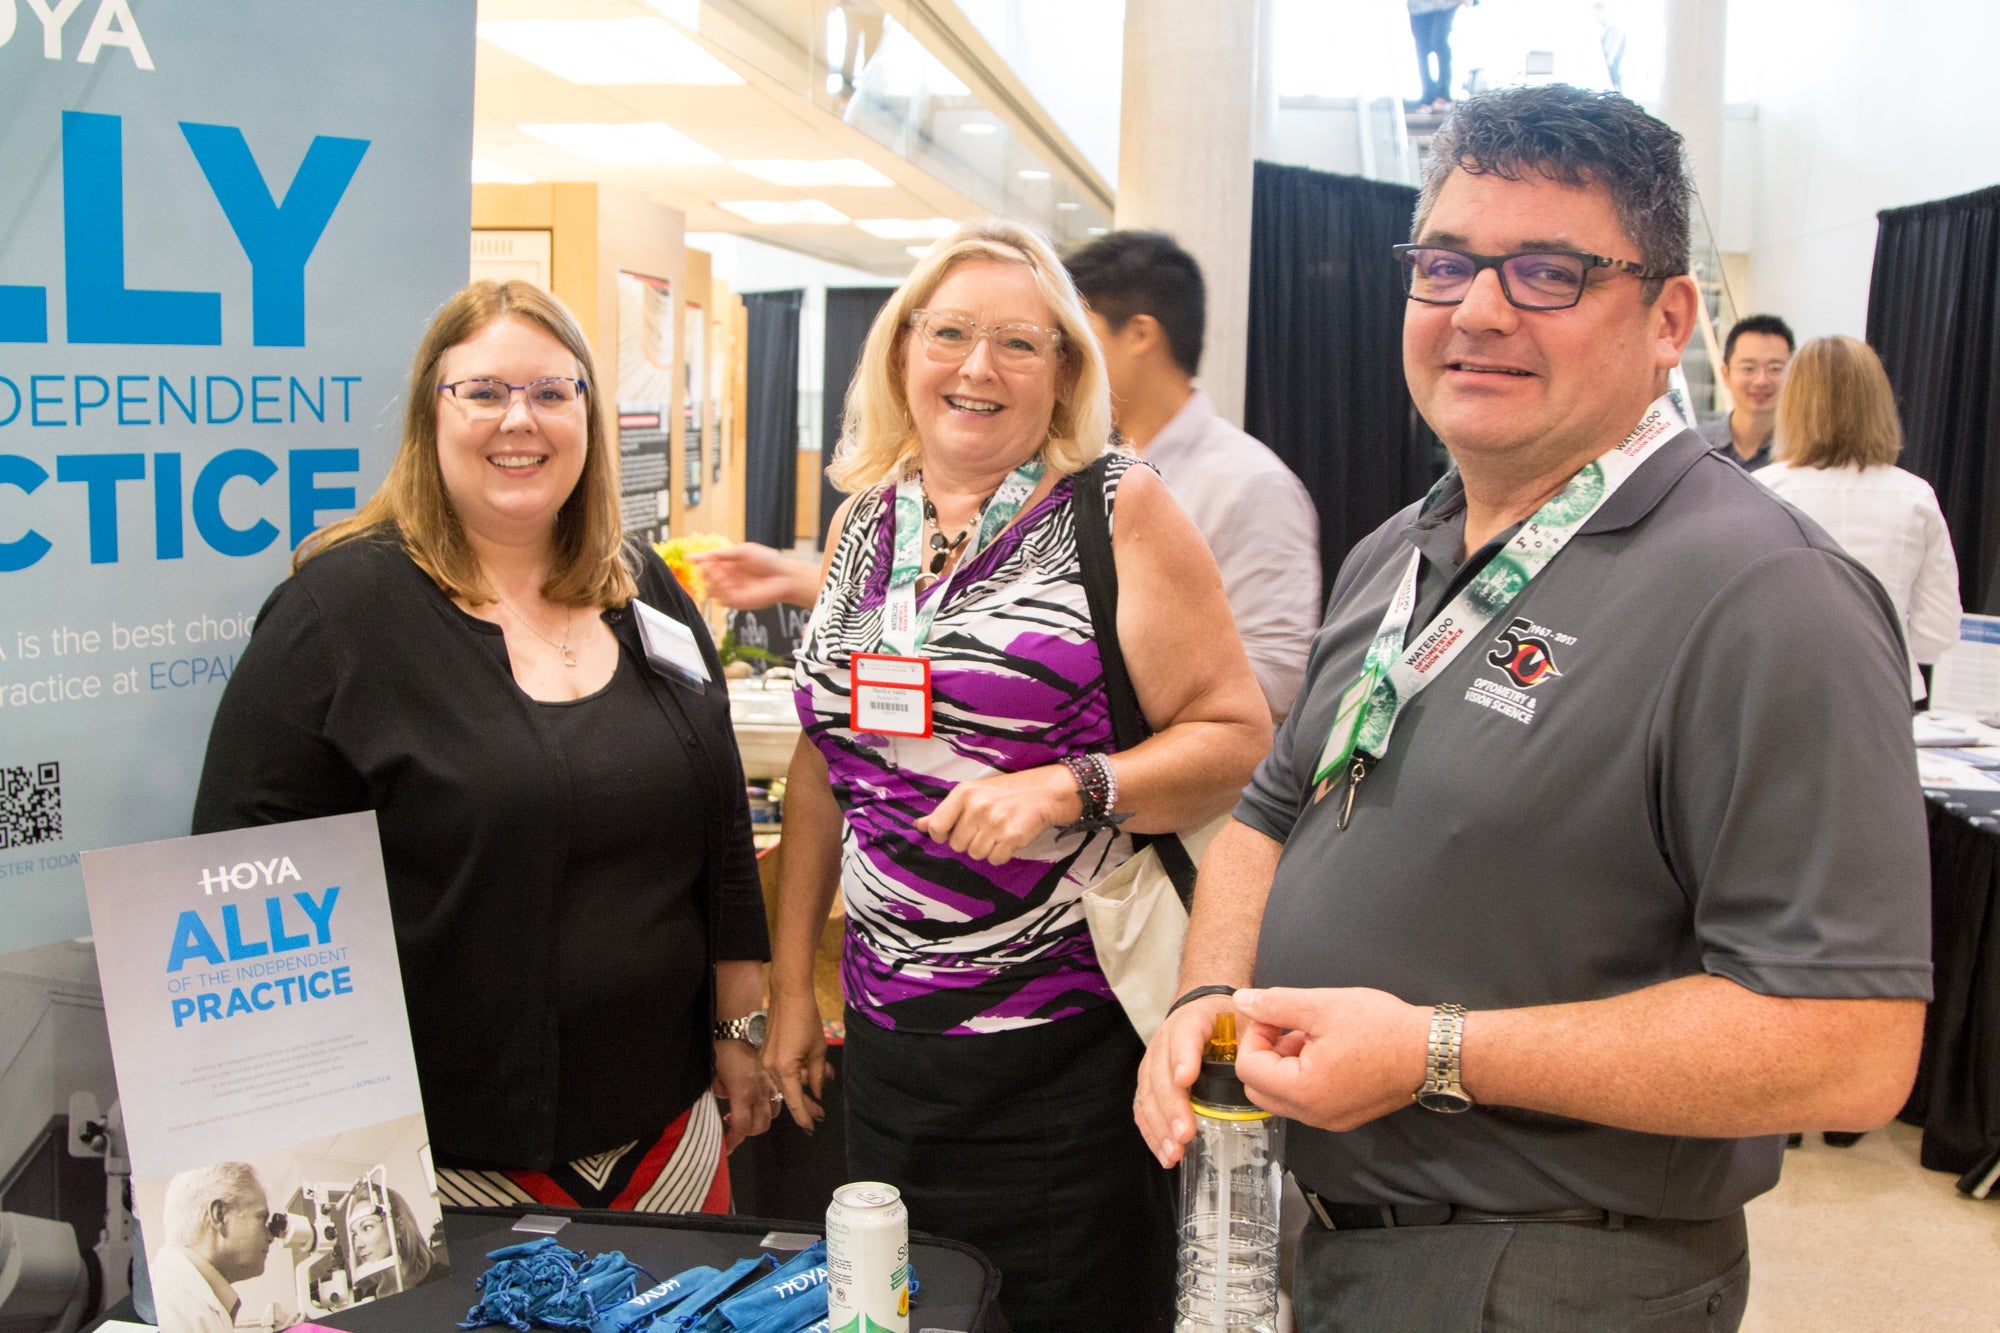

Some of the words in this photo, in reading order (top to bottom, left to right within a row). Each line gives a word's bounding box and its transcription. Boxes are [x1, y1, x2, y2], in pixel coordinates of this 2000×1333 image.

[0, 0, 155, 71] YA
[1614, 410, 1661, 451] WATERLOO
[17, 631, 41, 660] is
[51, 625, 101, 657] the
[112, 618, 176, 650] best
[1405, 618, 1453, 666] WATERLOO
[1414, 634, 1448, 671] OPTOMETRY
[1419, 655, 1440, 674] VISION
[1439, 628, 1464, 654] SCIENCE
[112, 666, 139, 695] at
[1473, 678, 1529, 705] OPTOMETRY
[1464, 690, 1493, 708] VISION
[1491, 701, 1533, 724] SCIENCE
[197, 856, 302, 895] HOYA
[166, 886, 341, 973] ALLY
[167, 976, 191, 993] OF
[197, 969, 231, 987] THE
[237, 947, 348, 981] INDEPENDENT
[171, 966, 353, 1028] PRACTICE
[772, 1267, 828, 1298] HOYA
